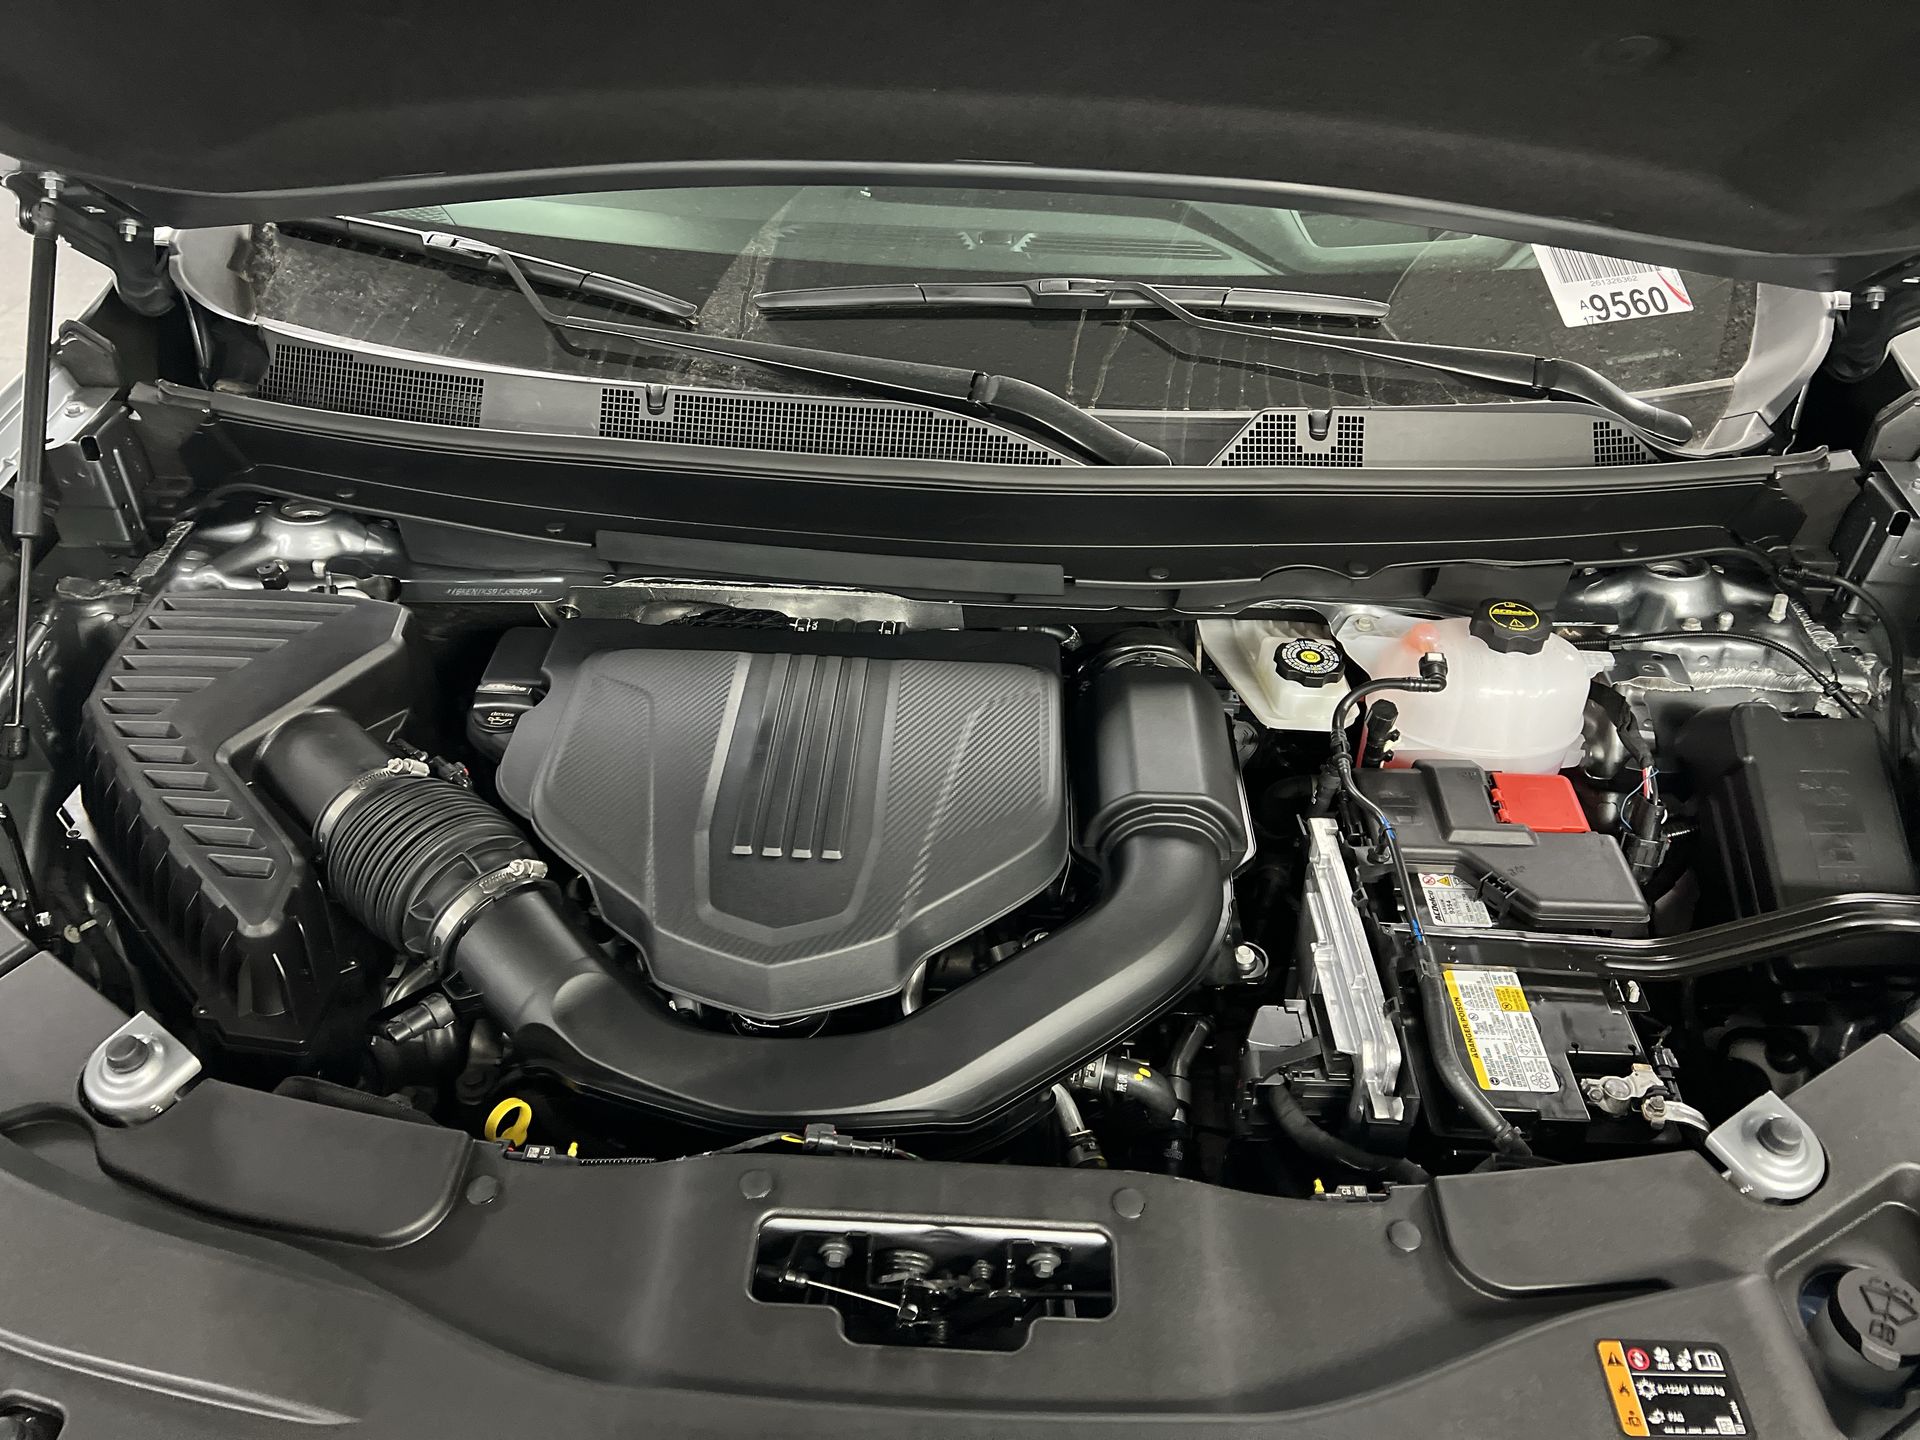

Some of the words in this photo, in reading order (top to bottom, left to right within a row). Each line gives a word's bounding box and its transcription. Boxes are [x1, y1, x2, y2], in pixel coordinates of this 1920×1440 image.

[1580, 299, 1589, 311] A
[1589, 286, 1669, 321] 9560
[1491, 608, 1534, 616] ACDelco
[1427, 890, 1443, 922] ACDelco
[543, 1147, 551, 1155] B
[1656, 1362, 1675, 1371] AUTO
